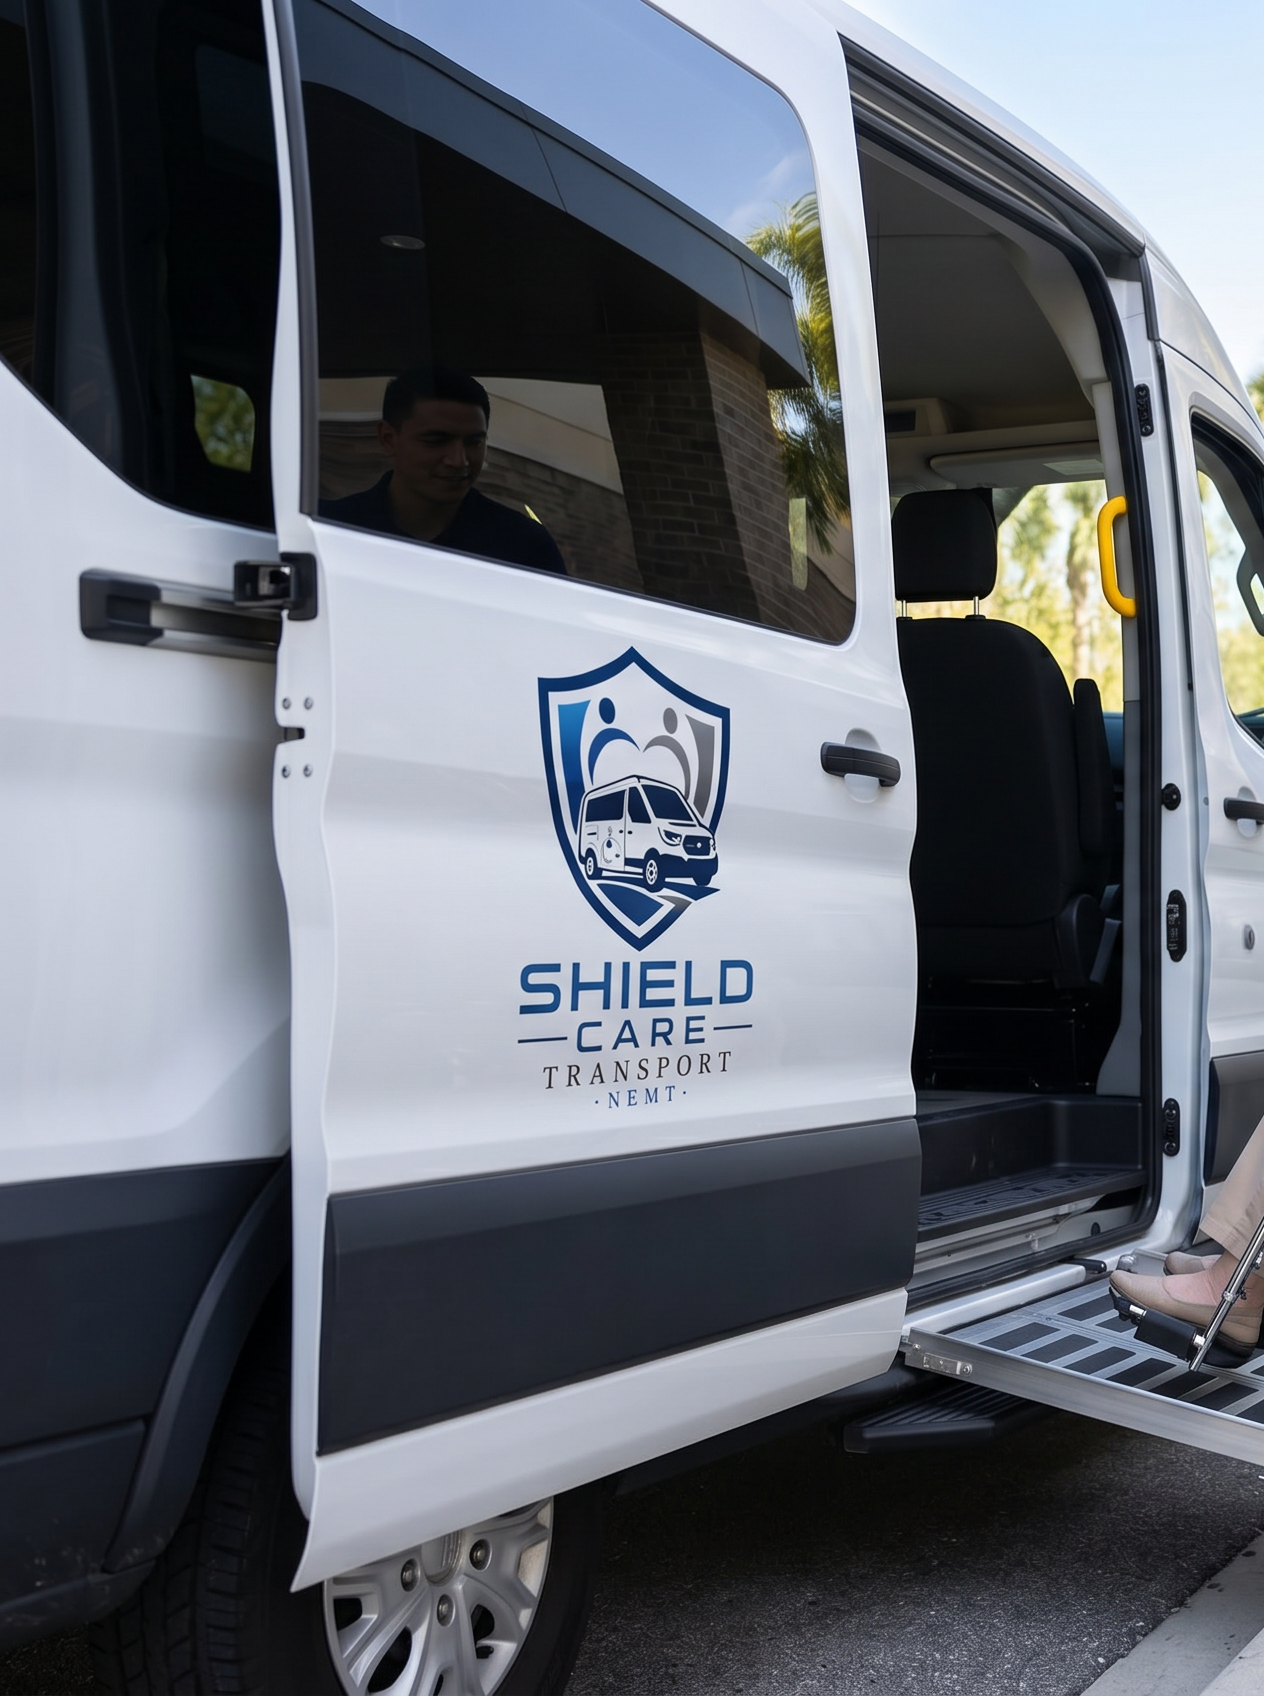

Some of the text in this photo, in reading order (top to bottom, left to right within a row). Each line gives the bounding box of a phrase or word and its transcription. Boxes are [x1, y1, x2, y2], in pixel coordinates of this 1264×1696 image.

[518, 959, 754, 1016] SHIELD
[576, 1015, 706, 1053] CARE
[542, 1051, 732, 1089] TRANSPORT
